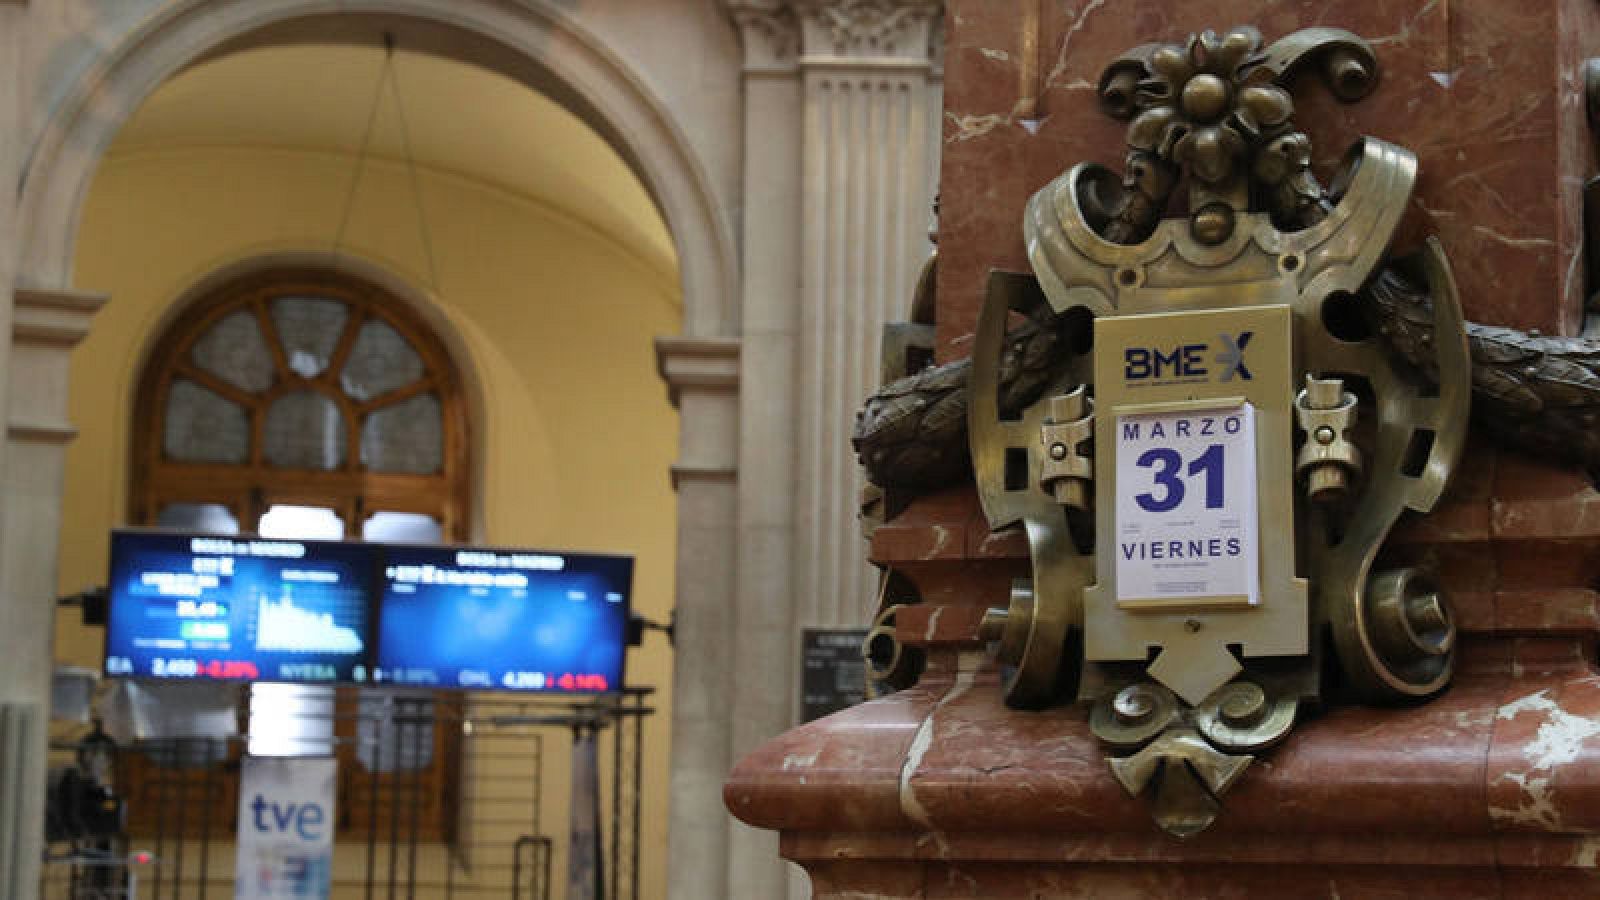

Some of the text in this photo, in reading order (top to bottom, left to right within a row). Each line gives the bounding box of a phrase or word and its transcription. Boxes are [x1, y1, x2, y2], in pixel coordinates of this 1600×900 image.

[1124, 343, 1209, 381] BME
[1123, 416, 1241, 441] MARZO
[1134, 444, 1225, 512] 31
[1121, 538, 1241, 561] VIERNES
[248, 792, 325, 841] tve
